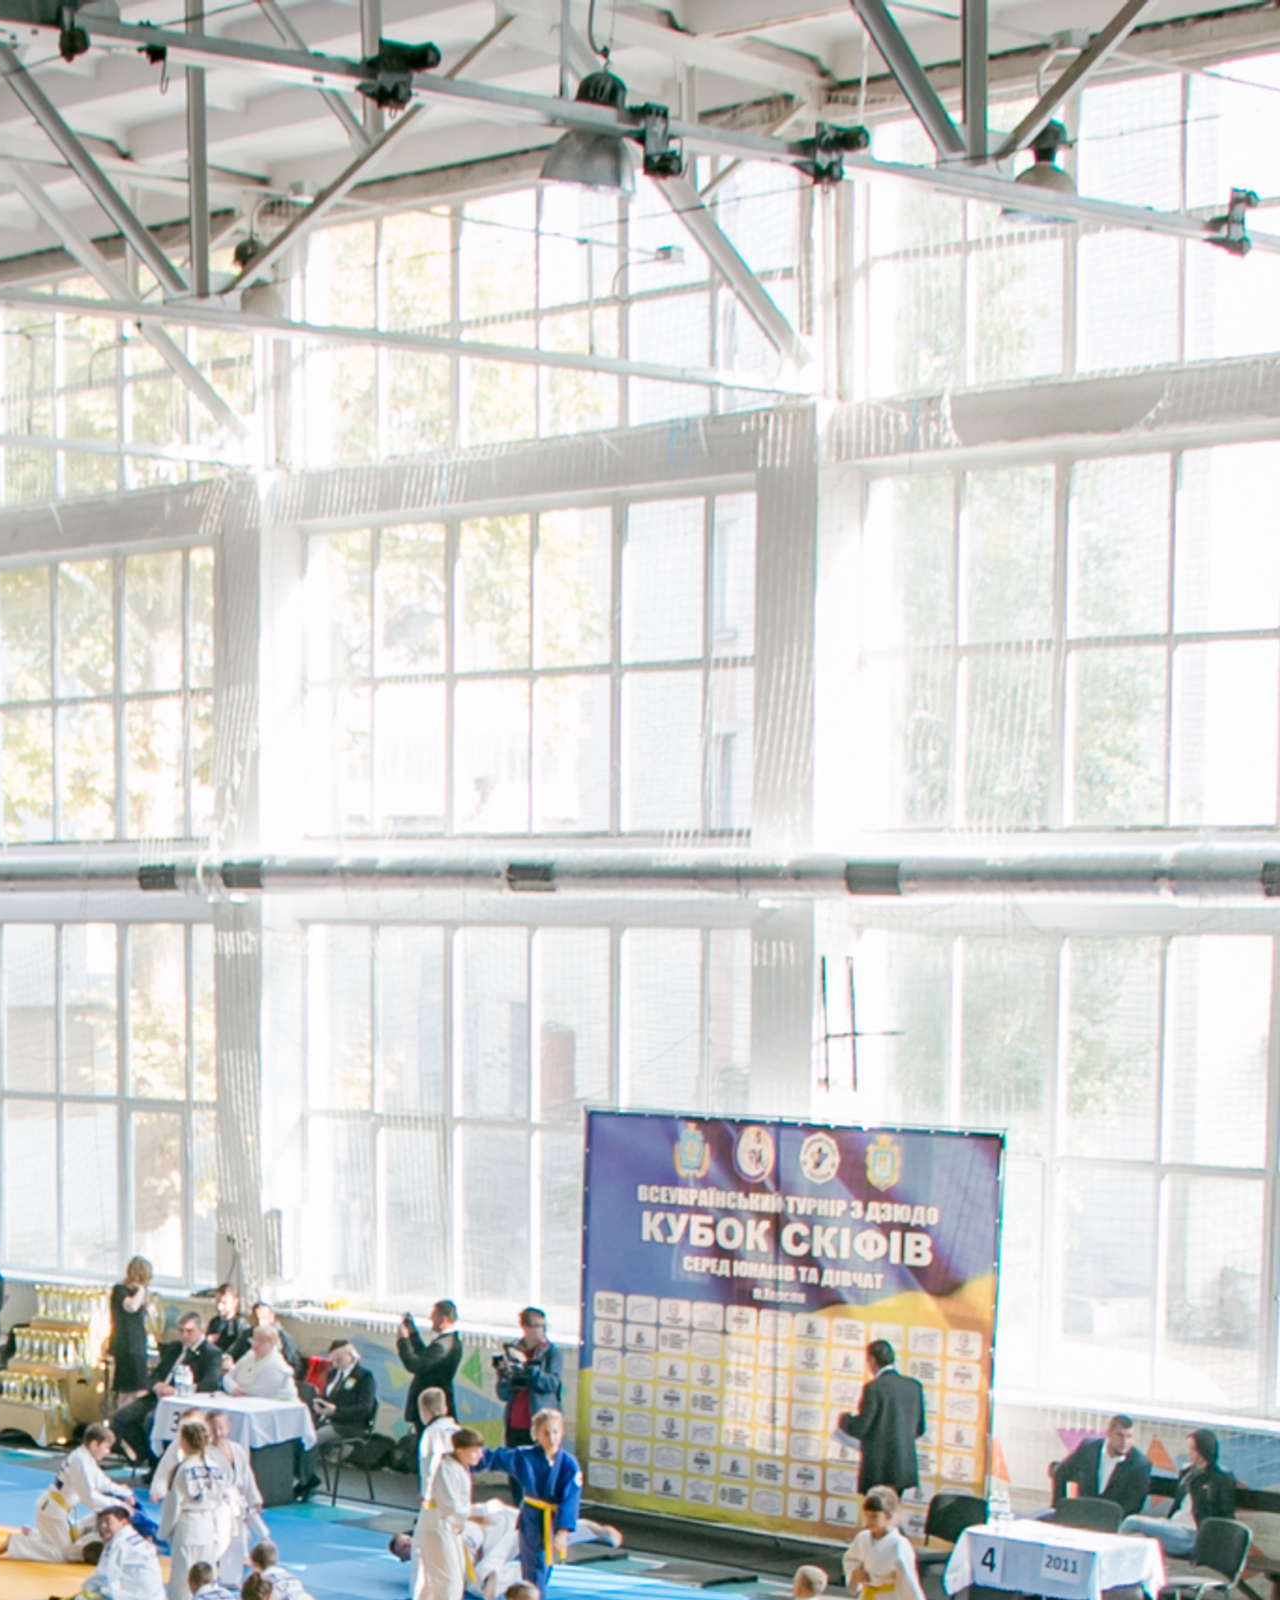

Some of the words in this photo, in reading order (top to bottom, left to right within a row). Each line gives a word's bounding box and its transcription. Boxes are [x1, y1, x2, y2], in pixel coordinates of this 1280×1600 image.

[637, 1184, 782, 1214] ВСЕУКРАЇНСЬКИЙ
[785, 1196, 848, 1217] ТУРНІР
[850, 1203, 864, 1220] З
[865, 1204, 939, 1227] ДЗЮДО
[640, 1210, 772, 1253] КУБОК
[780, 1222, 934, 1267] СКІФІВ
[682, 1256, 730, 1278] СЕРЕД
[797, 1266, 819, 1284] ТА
[821, 1269, 884, 1290] ДІВЧАТ
[980, 1547, 997, 1573] 4
[1044, 1554, 1078, 1575] 2011
